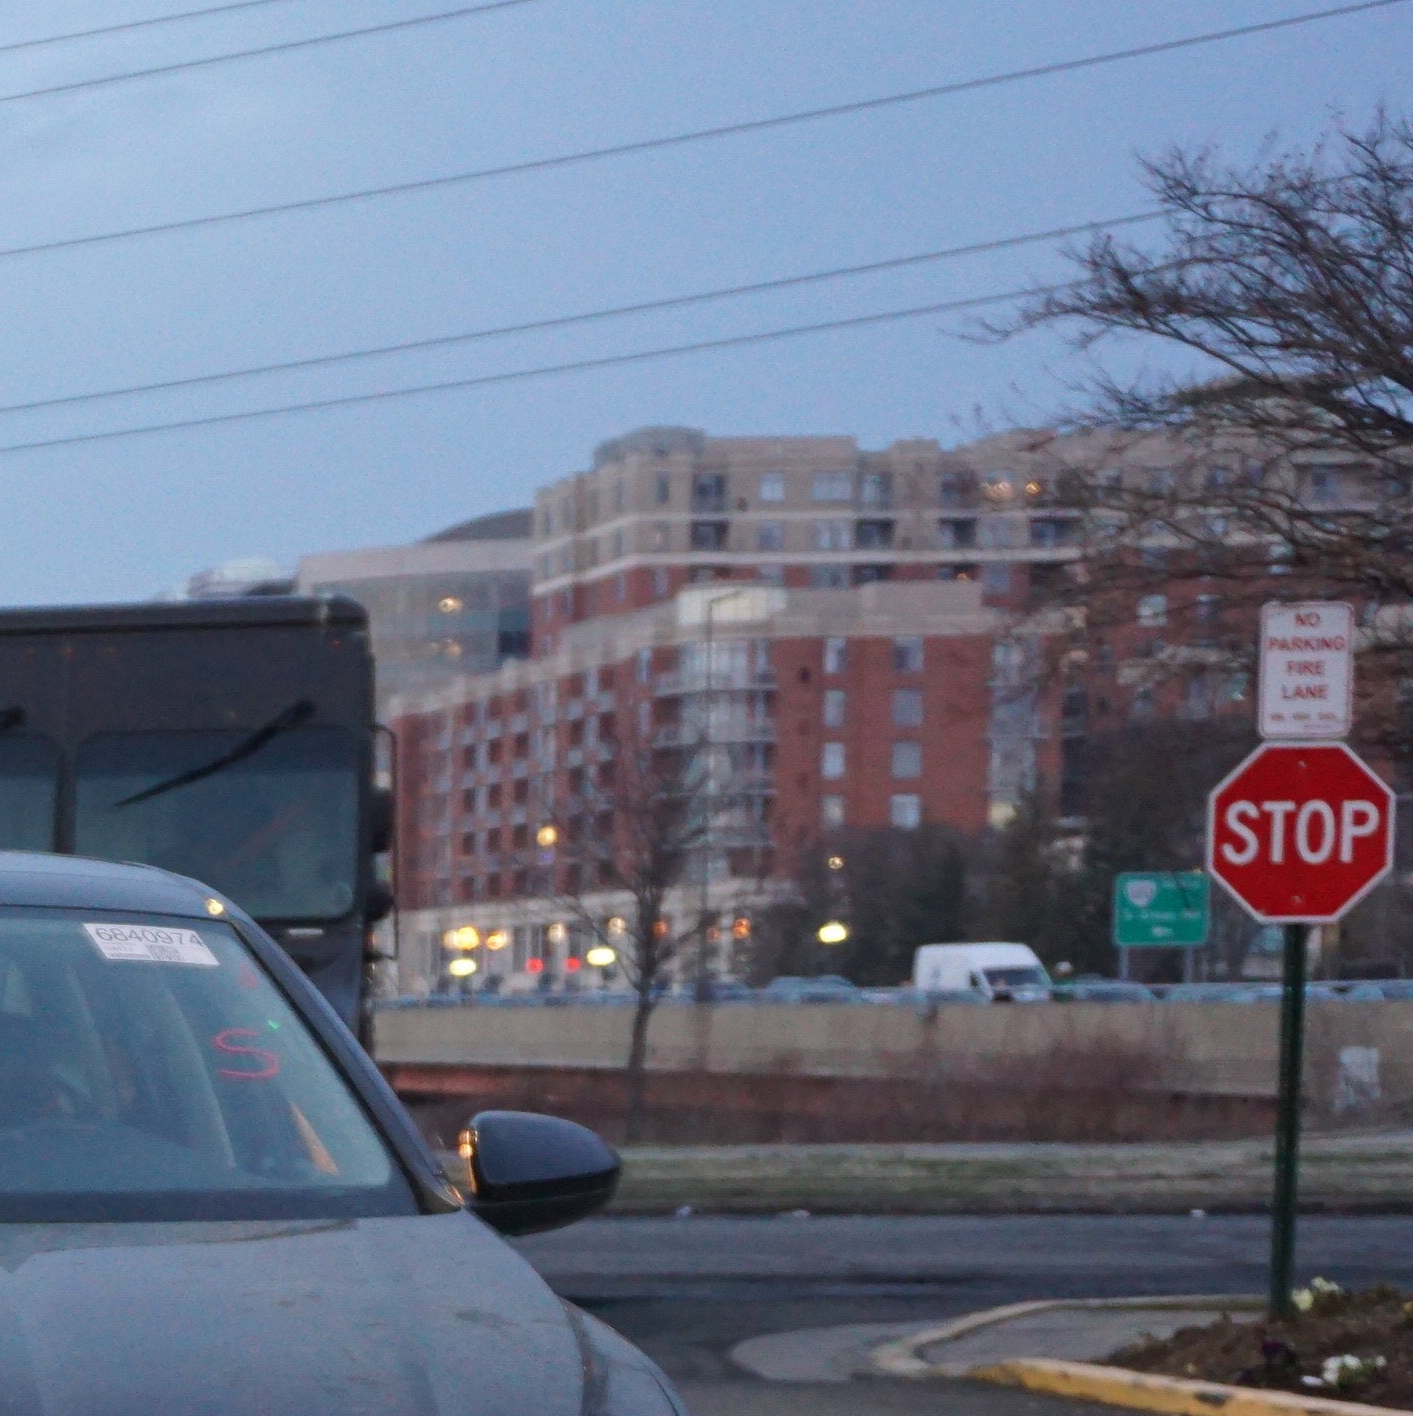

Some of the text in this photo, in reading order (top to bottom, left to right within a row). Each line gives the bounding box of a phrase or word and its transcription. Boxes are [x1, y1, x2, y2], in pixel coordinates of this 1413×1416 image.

[1294, 612, 1321, 627] NO
[1267, 637, 1346, 651] PARKING
[1286, 660, 1326, 676] FIRE
[1281, 684, 1329, 699] LANE
[1220, 799, 1381, 866] STOP
[95, 927, 204, 948] 6840974
